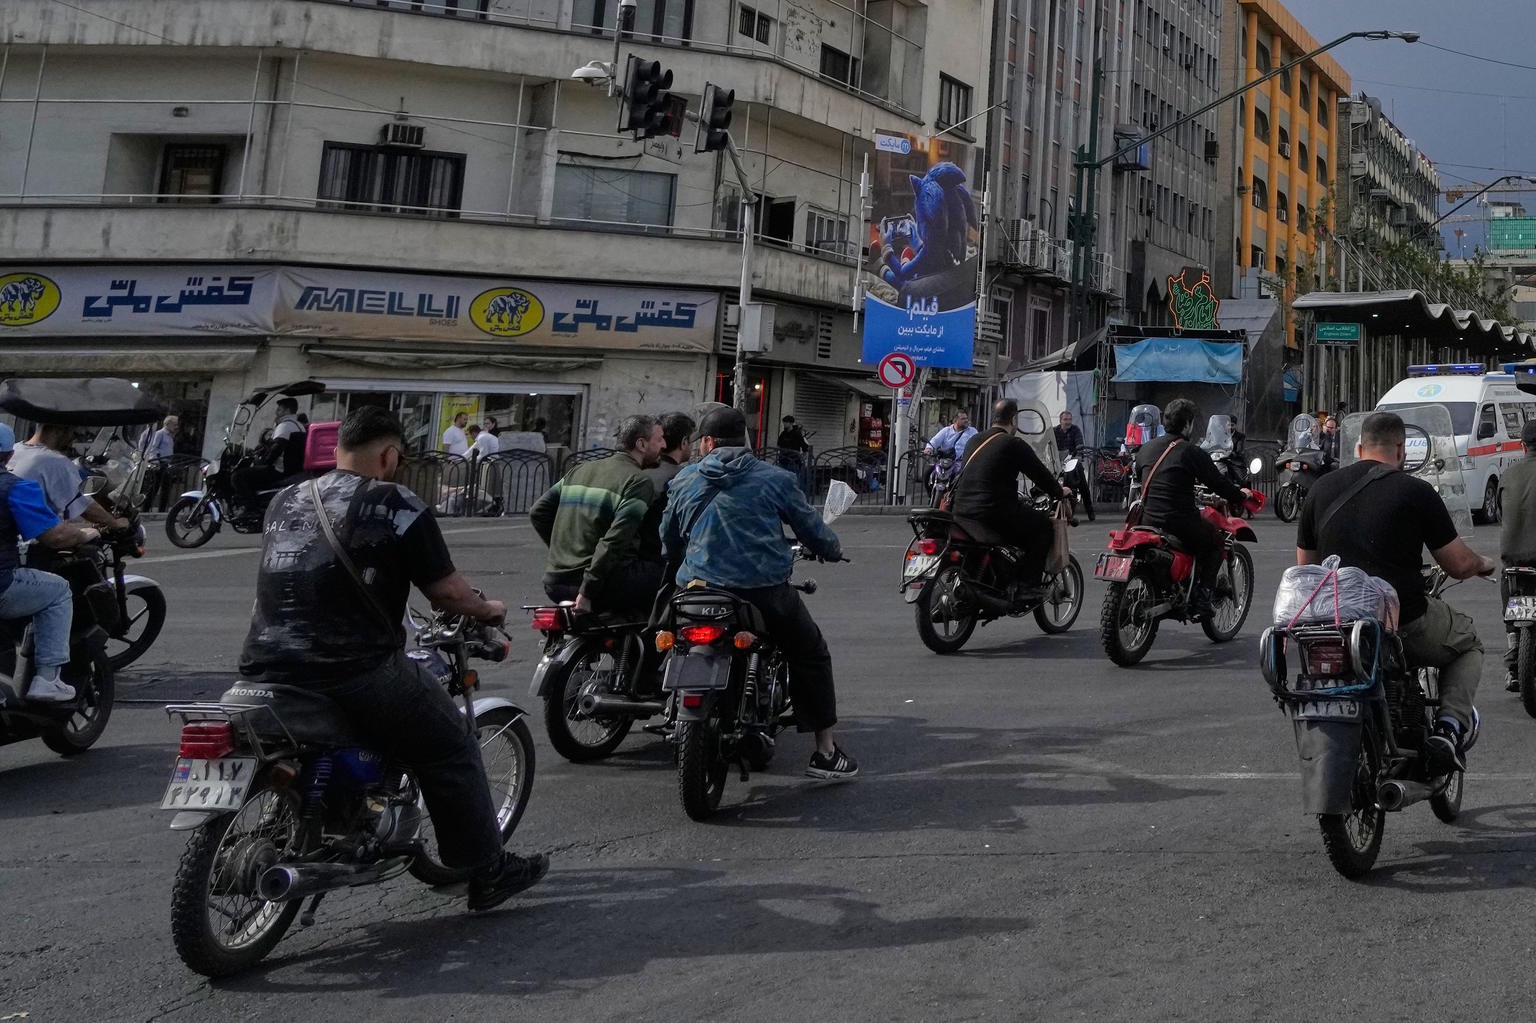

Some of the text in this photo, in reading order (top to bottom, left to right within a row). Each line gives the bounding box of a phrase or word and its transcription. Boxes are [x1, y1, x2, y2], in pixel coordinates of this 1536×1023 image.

[155, 276, 255, 314] کفش
[294, 286, 461, 319] MELLI
[429, 318, 458, 327] SHOES
[614, 300, 698, 333] کفش
[914, 324, 937, 335] مایکت
[936, 326, 944, 338] از
[230, 687, 274, 699] HONDA
